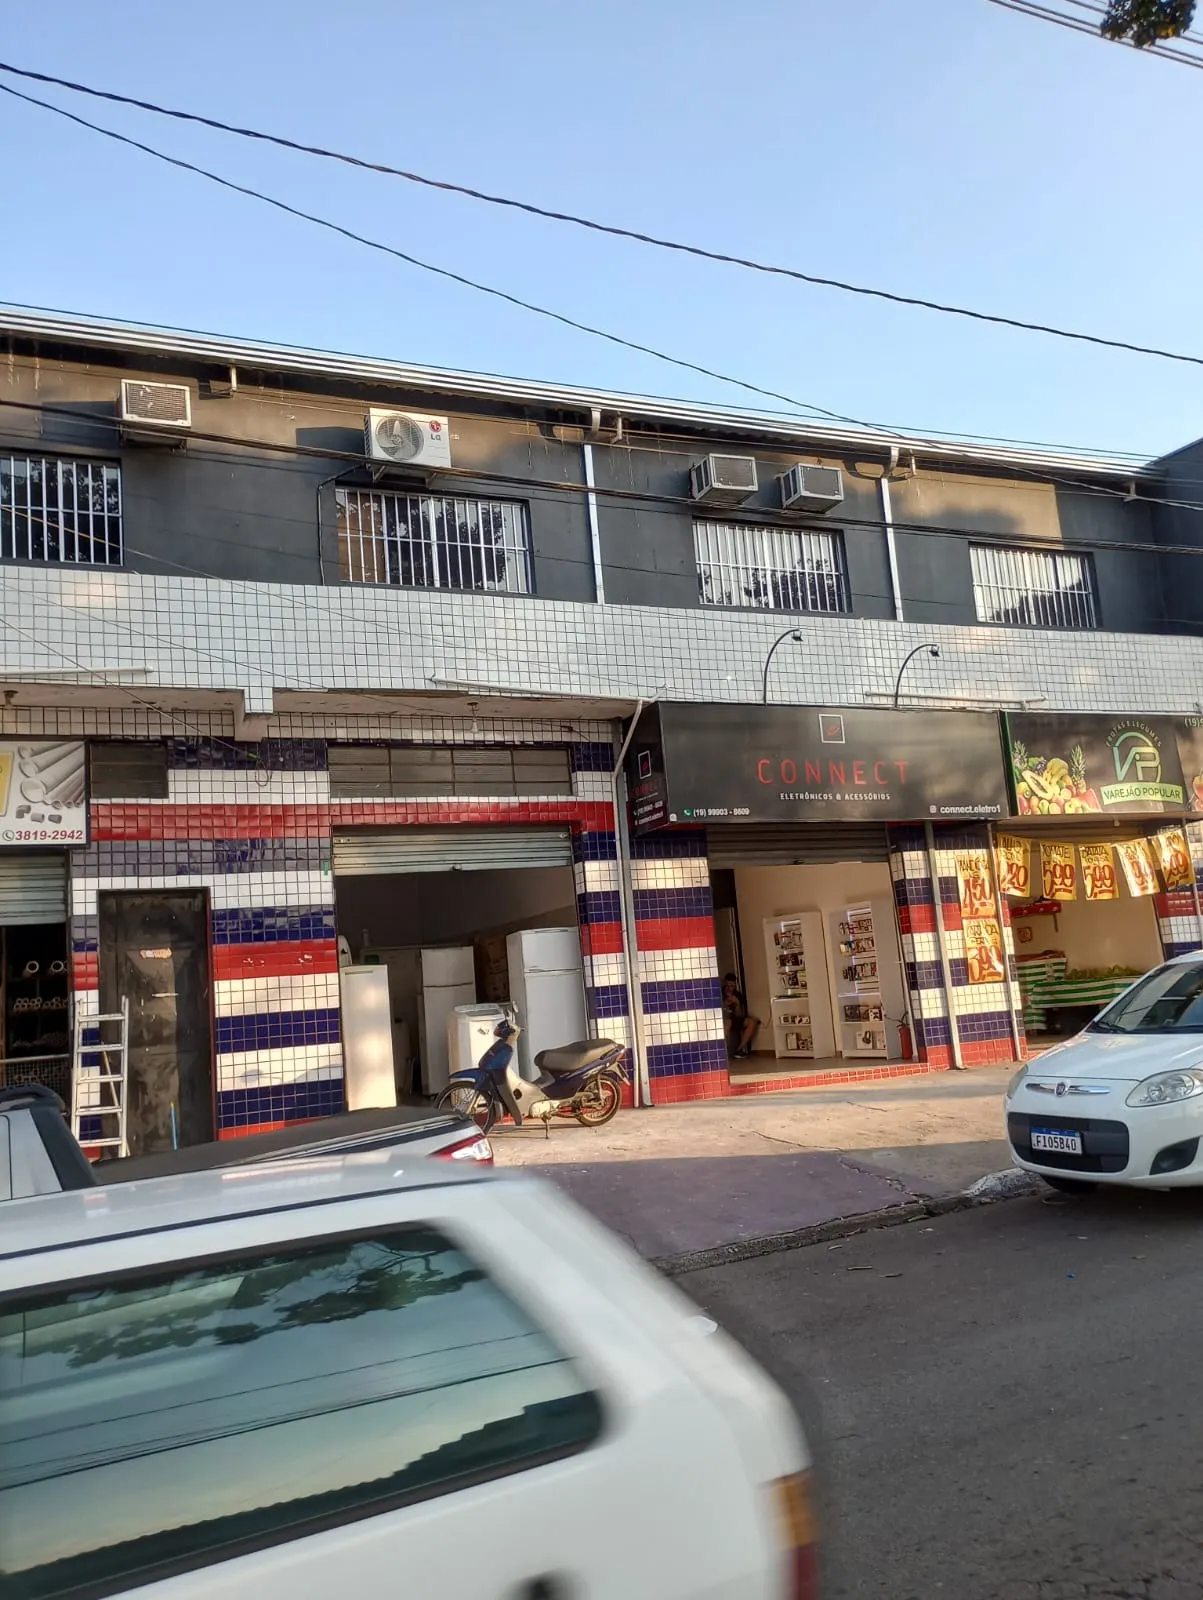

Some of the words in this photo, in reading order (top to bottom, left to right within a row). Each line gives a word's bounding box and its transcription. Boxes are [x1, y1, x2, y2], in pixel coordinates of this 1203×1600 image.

[757, 758, 909, 786] CONNECT
[780, 791, 833, 801] ELETRÔNICOS
[844, 792, 891, 801] ACESSÓRIOS
[1103, 785, 1141, 800] VAREJÃO
[1142, 787, 1180, 800] POPULAR
[15, 829, 83, 841] 3819-2942
[1036, 1135, 1077, 1152] FIO5B40
